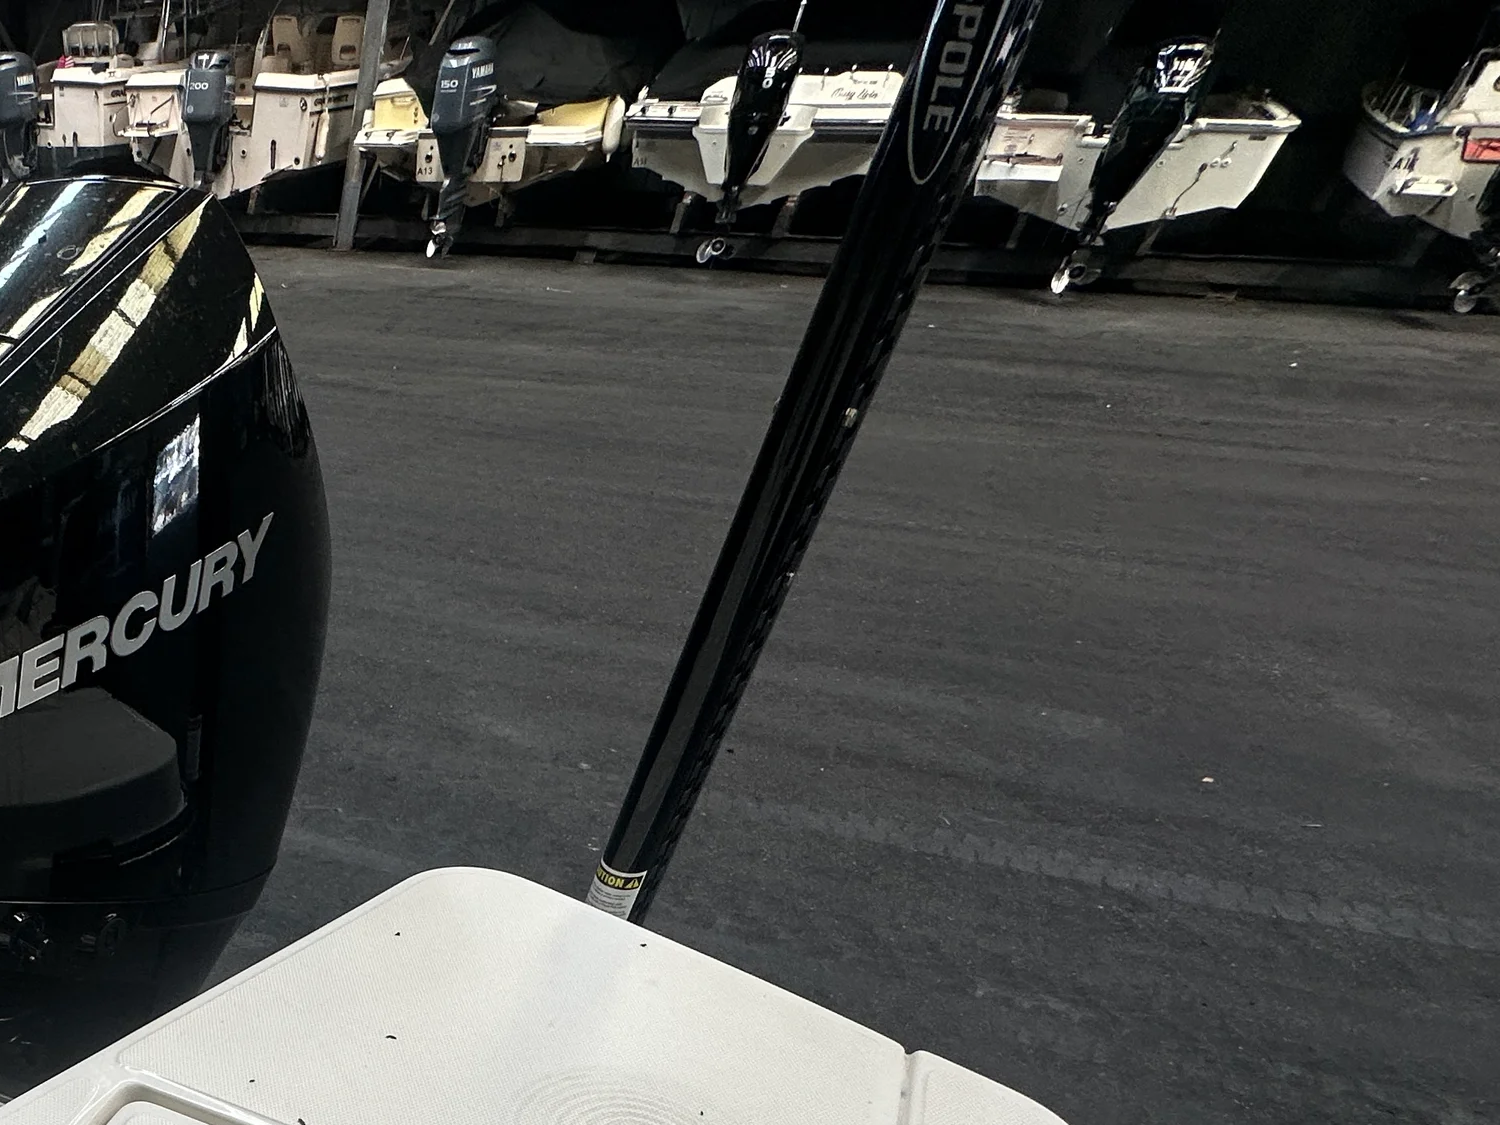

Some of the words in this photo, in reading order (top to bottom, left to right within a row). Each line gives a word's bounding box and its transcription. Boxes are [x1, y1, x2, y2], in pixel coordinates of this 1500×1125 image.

[189, 82, 209, 91] 200
[440, 80, 459, 89] 150
[417, 167, 433, 175] A13
